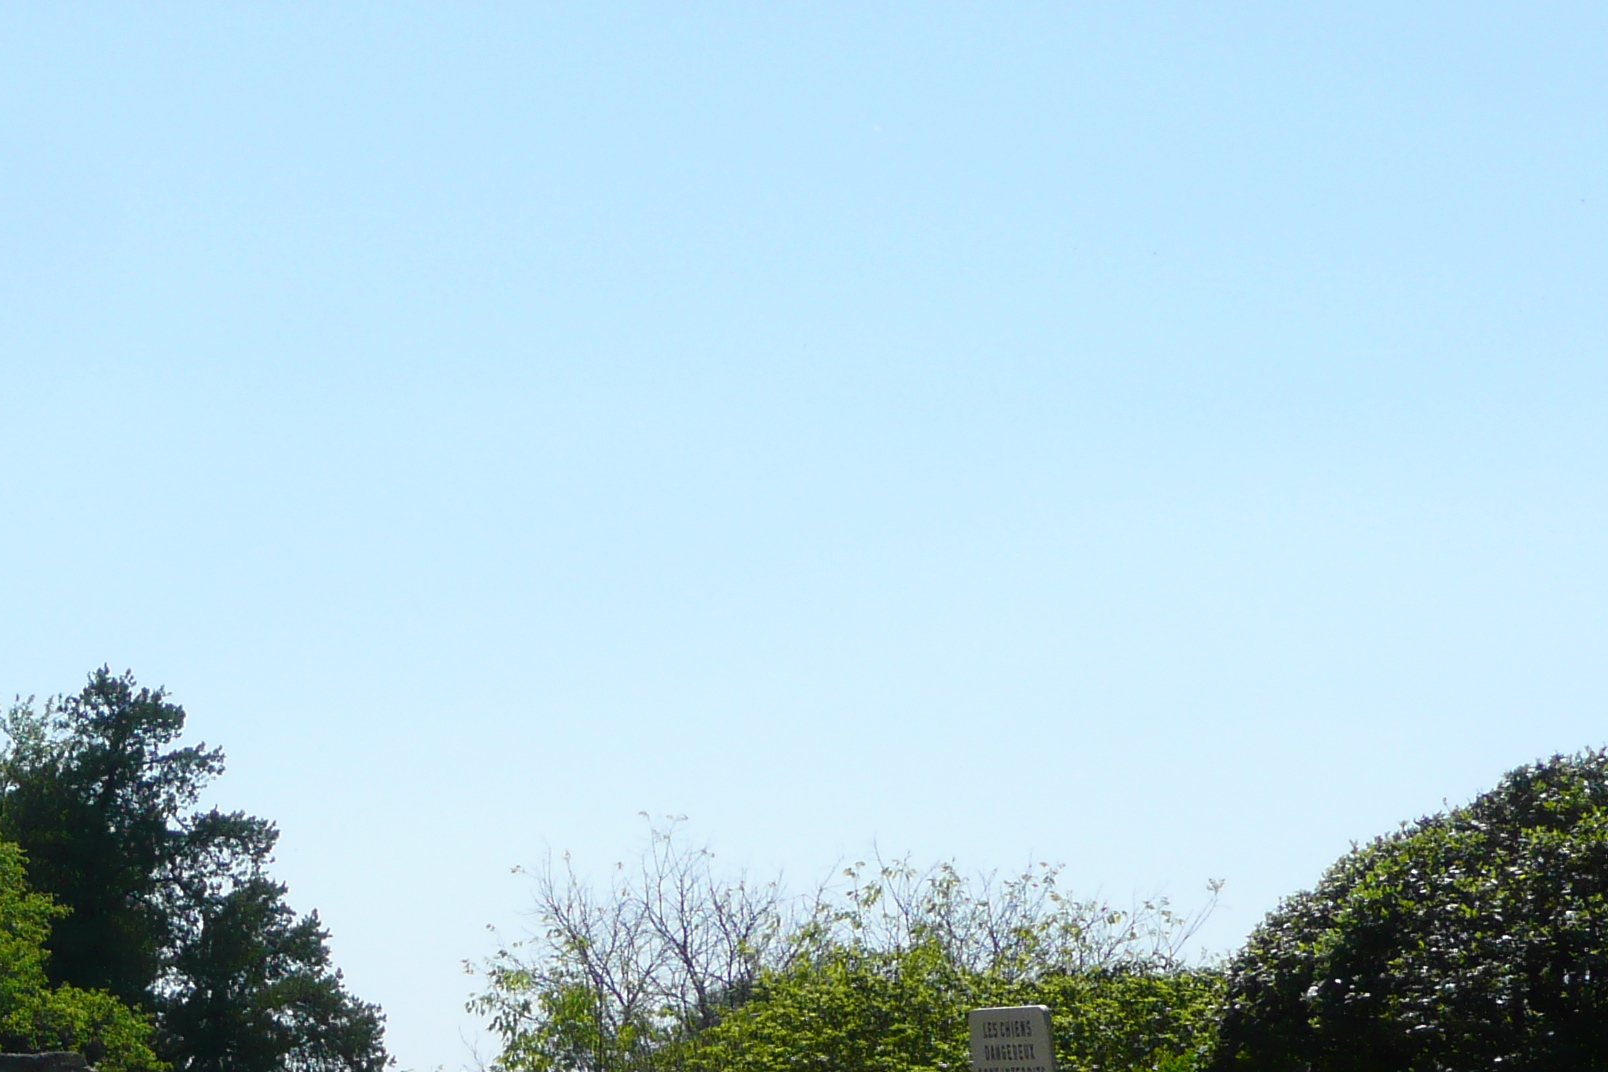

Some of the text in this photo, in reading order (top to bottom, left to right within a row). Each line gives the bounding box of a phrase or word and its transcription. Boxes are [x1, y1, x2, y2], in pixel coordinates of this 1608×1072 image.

[982, 1020, 1032, 1038] LES CHIENS
[984, 1044, 1035, 1060] DANGEREUX
